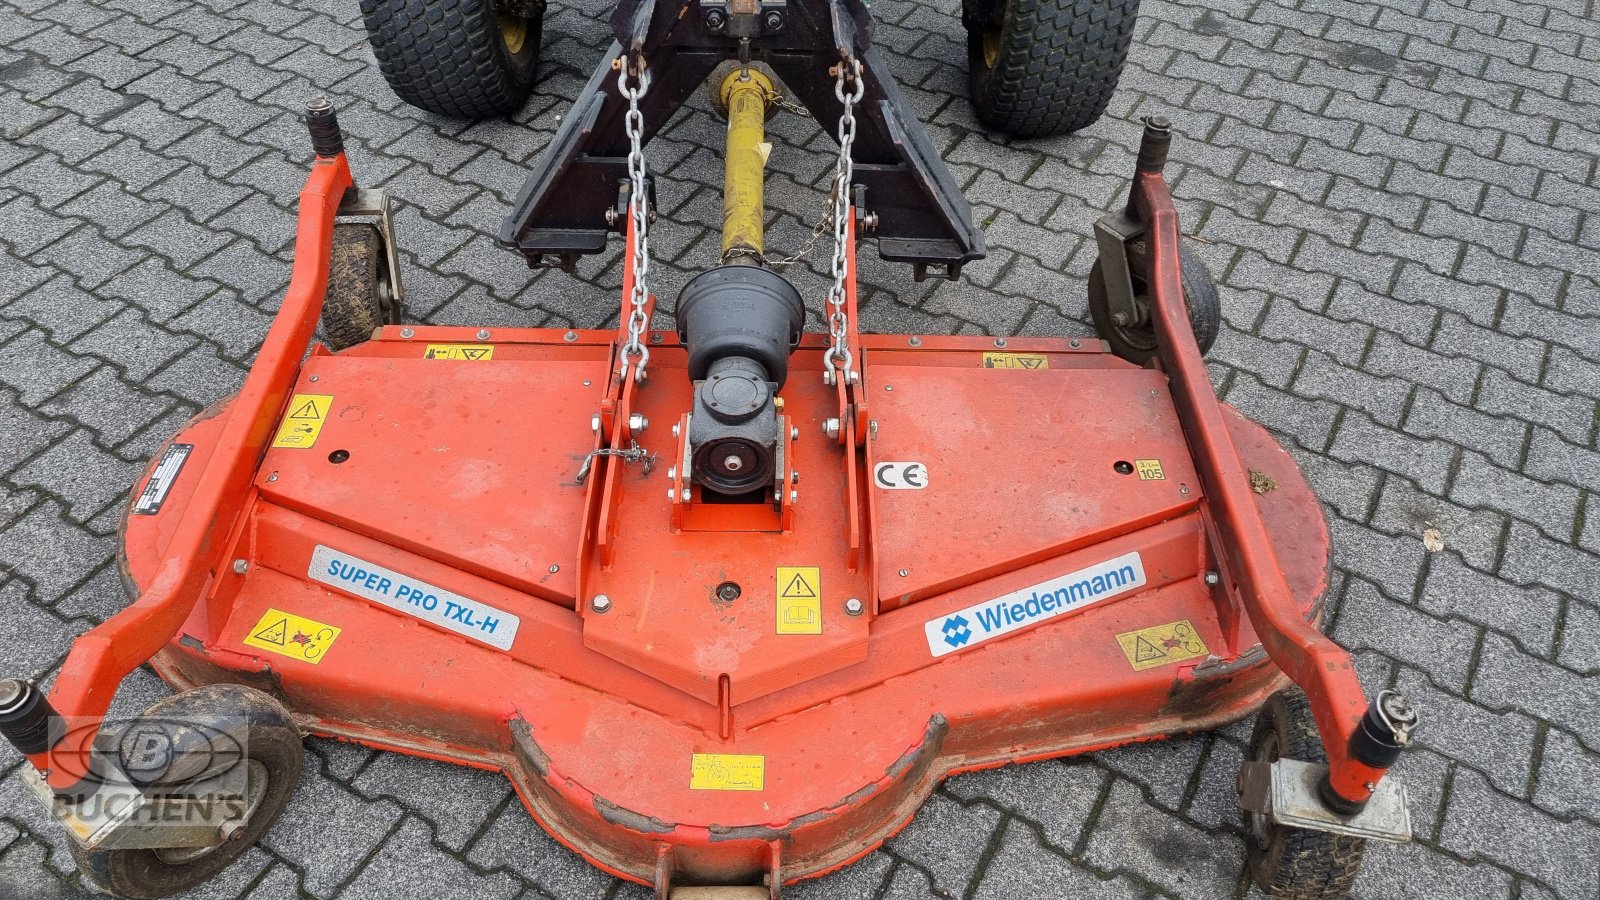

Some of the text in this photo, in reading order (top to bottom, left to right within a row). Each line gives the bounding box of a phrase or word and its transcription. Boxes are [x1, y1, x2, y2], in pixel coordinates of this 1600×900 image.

[877, 464, 922, 487] CE
[1140, 468, 1163, 479] 105
[327, 559, 500, 634] SUPER PRO TXL-H
[976, 565, 1136, 632] Wiedenmann
